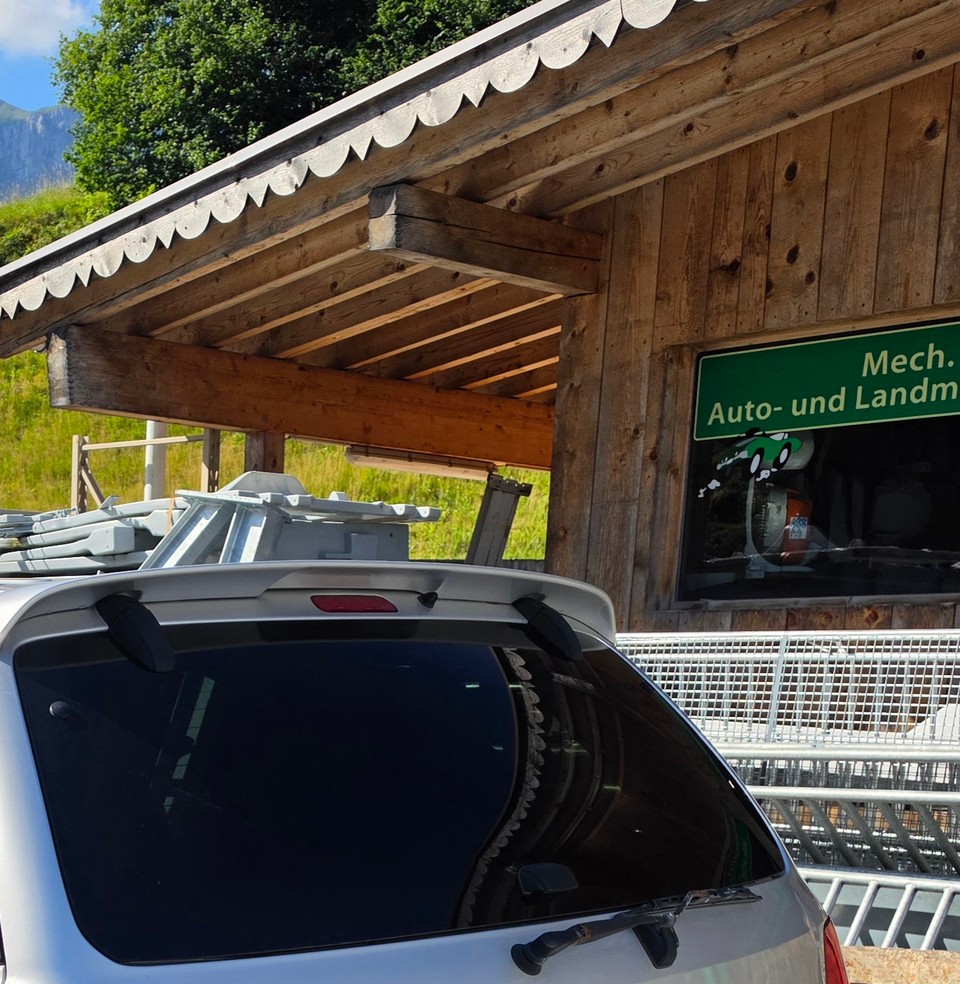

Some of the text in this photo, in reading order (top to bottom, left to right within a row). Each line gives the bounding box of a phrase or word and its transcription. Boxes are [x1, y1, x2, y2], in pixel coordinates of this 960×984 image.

[862, 343, 955, 377] Mech.
[707, 401, 783, 426] Auto-
[791, 386, 846, 417] und
